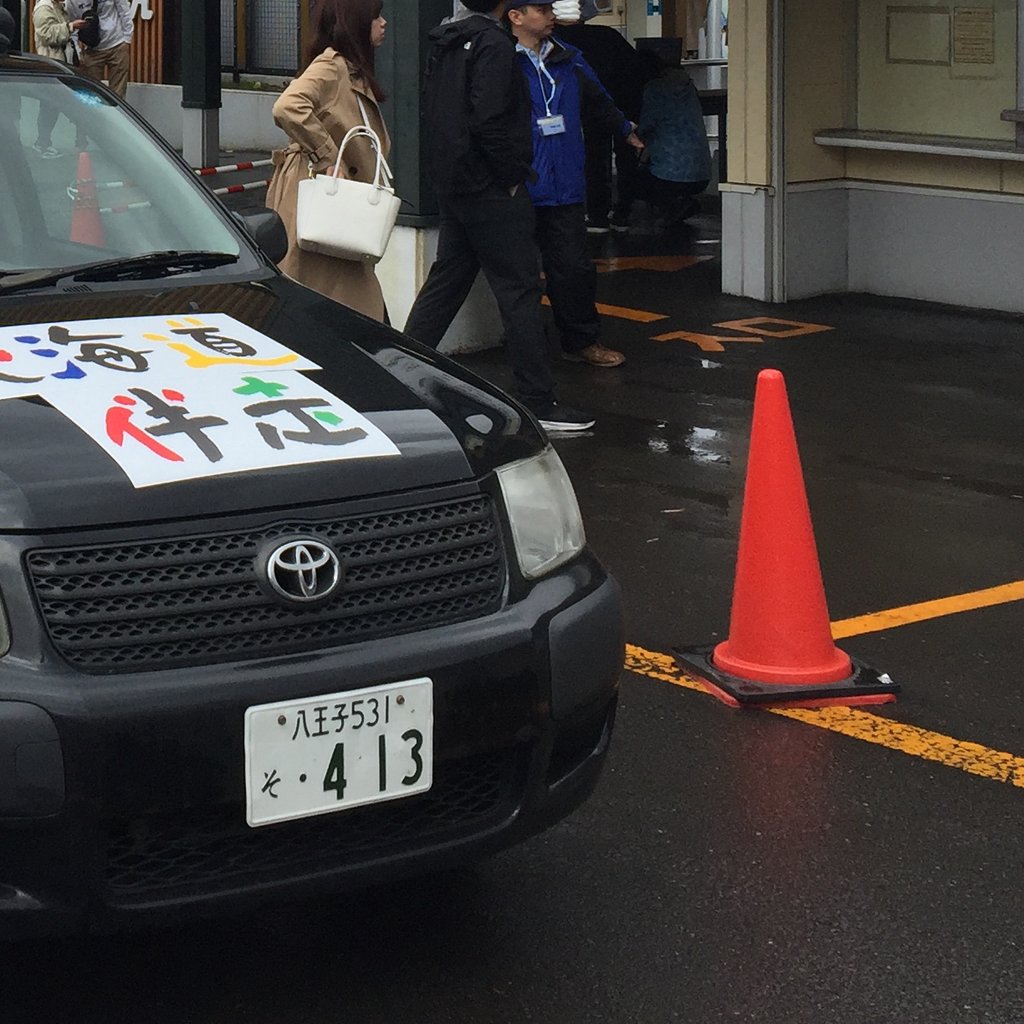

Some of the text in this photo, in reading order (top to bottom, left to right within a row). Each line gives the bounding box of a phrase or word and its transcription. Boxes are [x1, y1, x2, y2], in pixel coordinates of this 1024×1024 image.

[292, 695, 390, 741] 八王子531
[261, 769, 281, 799] そ
